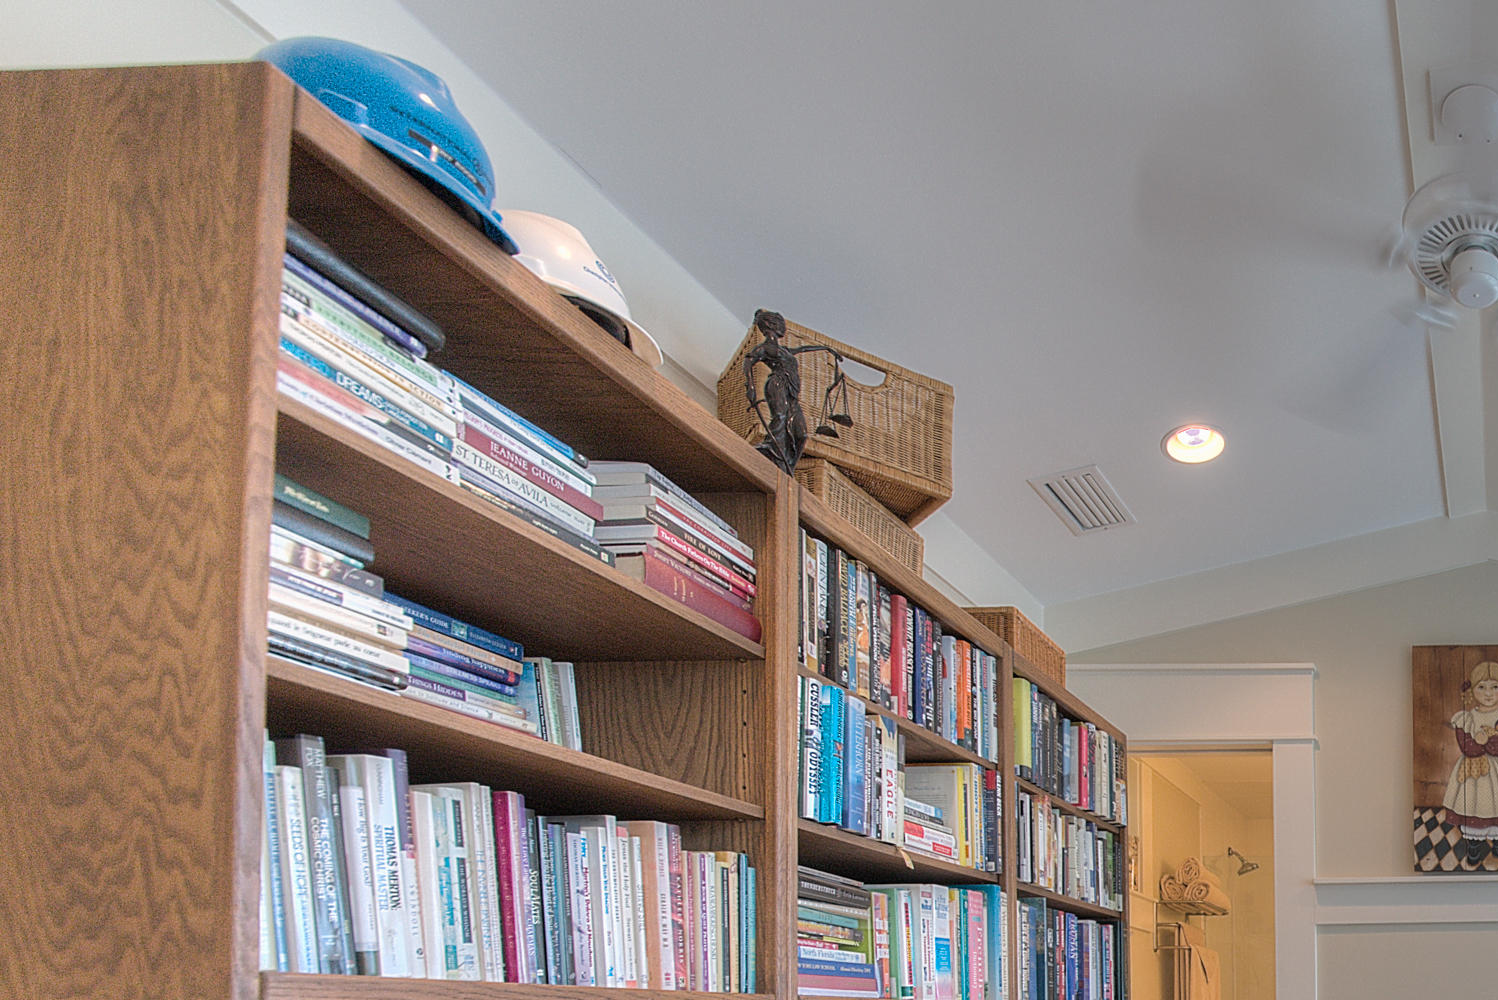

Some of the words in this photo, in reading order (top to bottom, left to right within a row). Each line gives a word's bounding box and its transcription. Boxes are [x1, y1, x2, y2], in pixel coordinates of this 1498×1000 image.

[336, 371, 385, 409] DREAMS
[471, 452, 511, 485] TERESA
[518, 482, 549, 508] AVILA
[490, 441, 529, 471] JEANNE
[531, 466, 565, 491] GUYON
[840, 556, 848, 586] DAVID
[430, 614, 450, 629] GUIDE
[840, 587, 848, 635] BALDACCI
[407, 674, 432, 689] THINGS
[432, 681, 464, 699] HIDDEN
[808, 682, 819, 727] CUSSLER
[306, 746, 317, 767] FOX
[854, 712, 864, 775] MATTERHORN
[315, 748, 327, 799] MATTHEW
[807, 751, 819, 796] ODYSSEY
[885, 769, 893, 819] EAGLE
[309, 816, 321, 856] COSMIC
[318, 817, 331, 839] THE
[373, 824, 387, 871] SPIRITUAL
[384, 826, 397, 869] THOMAS
[313, 857, 326, 901] CHRIST
[319, 839, 336, 882] COMING
[325, 883, 336, 900] OF
[326, 900, 339, 922] THE
[377, 873, 389, 912] MASTER
[390, 870, 402, 911] MERTON:
[1069, 919, 1077, 959] TRUMAN
